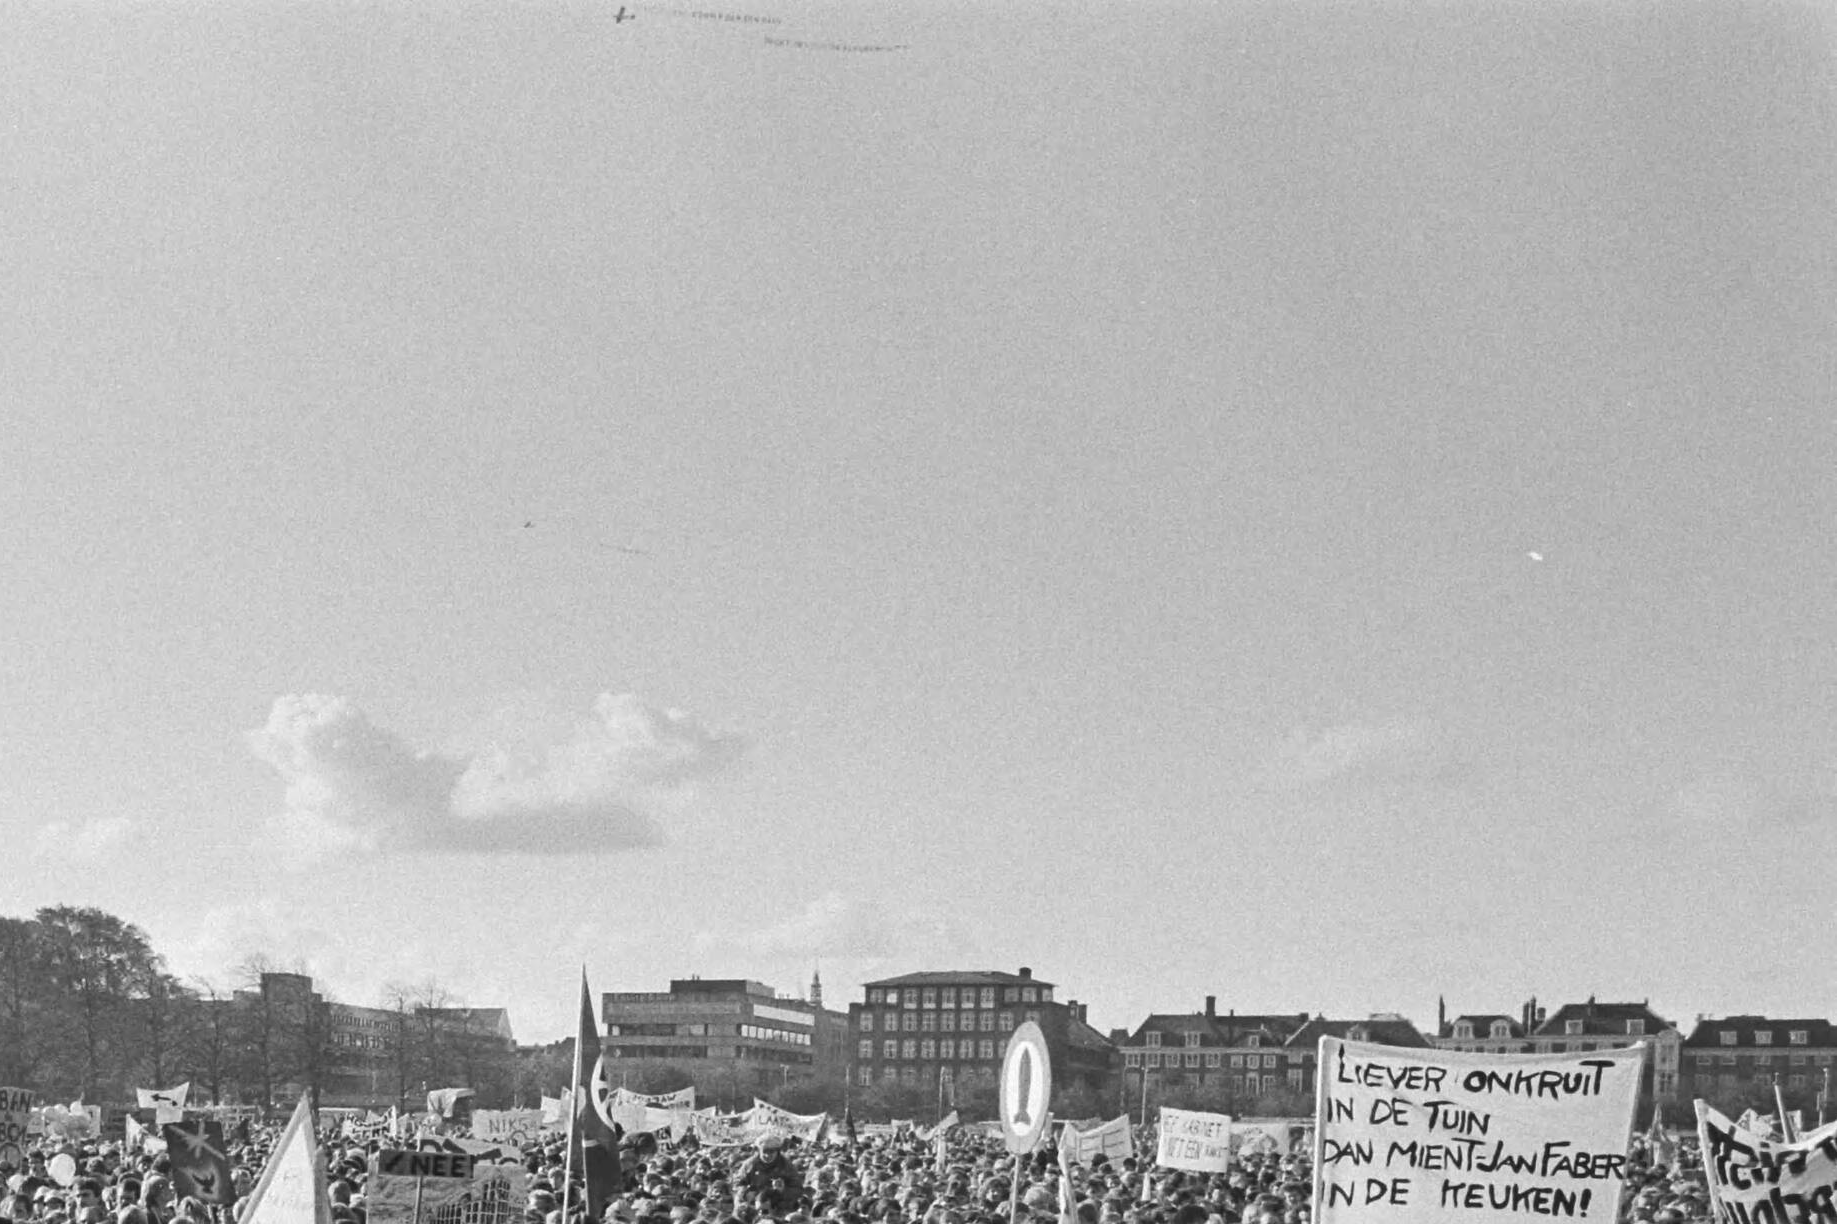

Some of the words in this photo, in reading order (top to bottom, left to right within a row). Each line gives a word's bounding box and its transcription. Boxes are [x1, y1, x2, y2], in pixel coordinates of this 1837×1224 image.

[1338, 1044, 1447, 1092] LIEVER
[1464, 1060, 1616, 1100] ONKRUIT
[1327, 1098, 1354, 1123] IN
[1369, 1098, 1410, 1126] DE
[1423, 1100, 1491, 1135] TUIN
[411, 1154, 466, 1178] NEE
[1322, 1139, 1373, 1167] DAN
[1541, 1141, 1629, 1180] FABER
[1321, 1180, 1355, 1207] IN
[1366, 1179, 1410, 1205] DE
[1441, 1179, 1592, 1218] KEUKEN!
